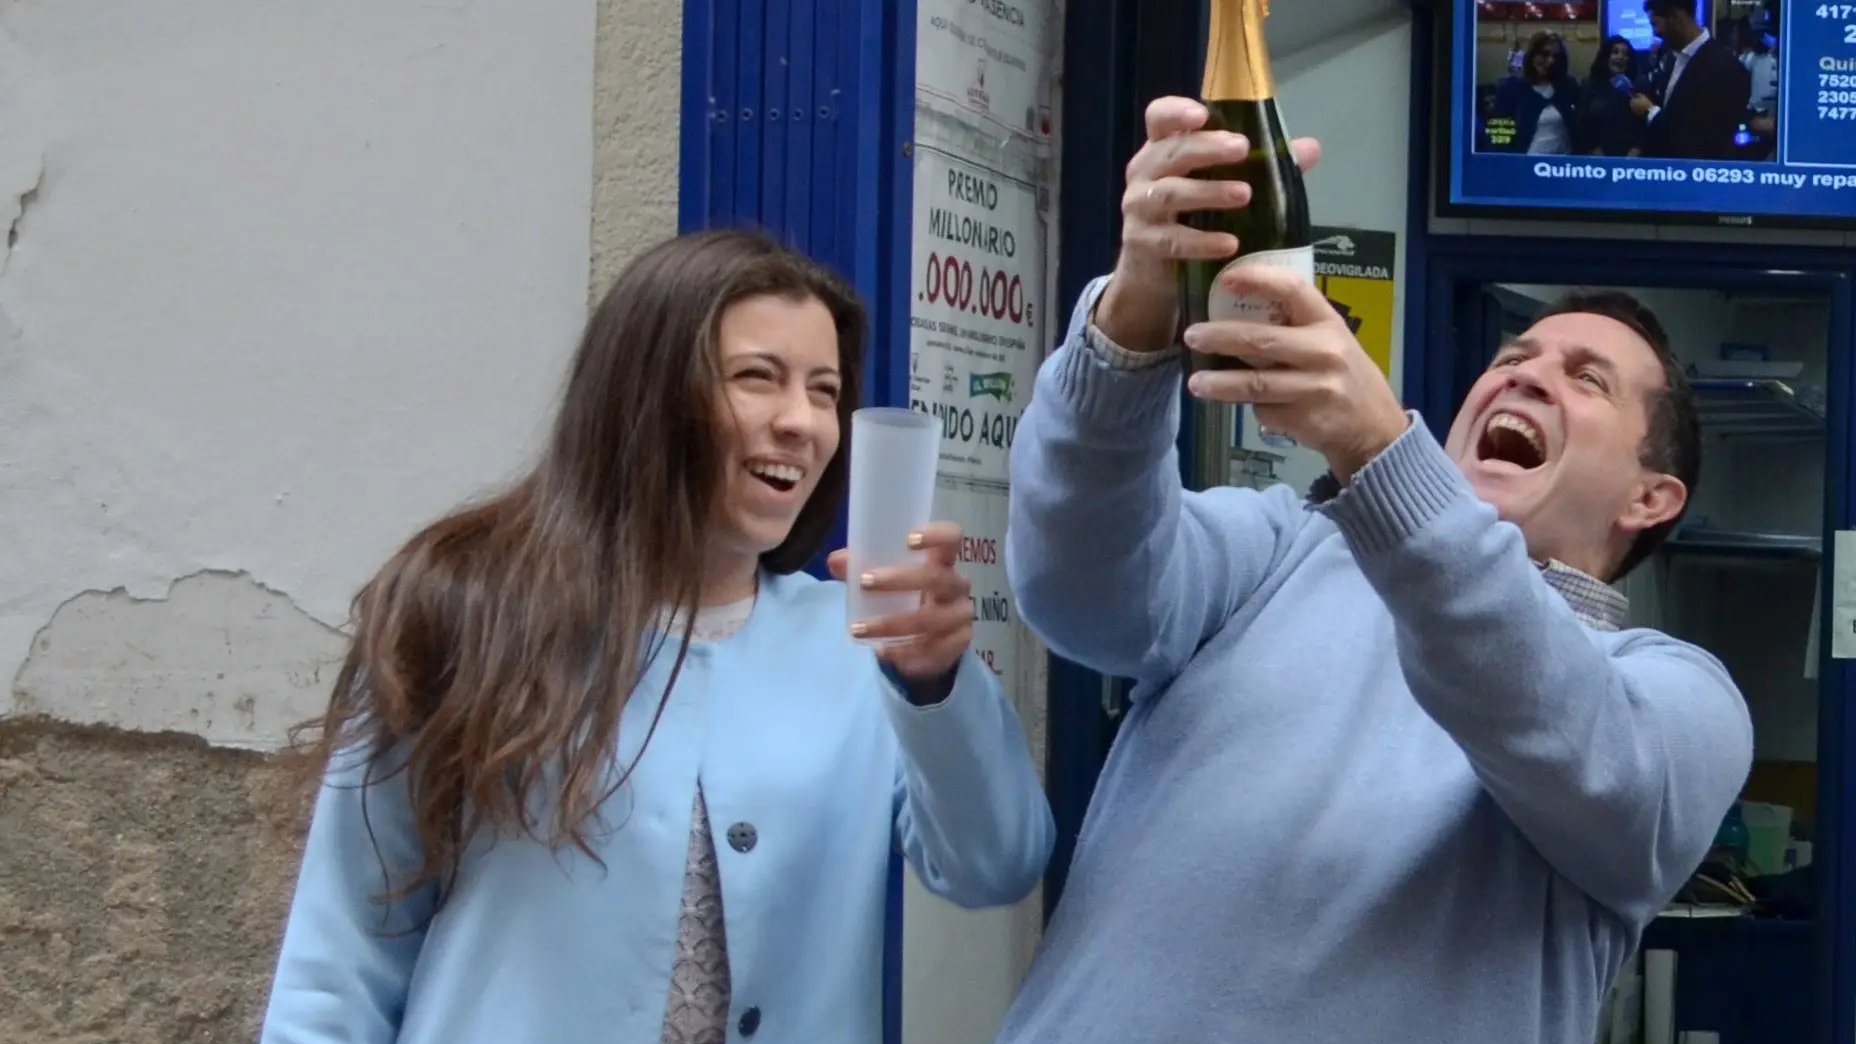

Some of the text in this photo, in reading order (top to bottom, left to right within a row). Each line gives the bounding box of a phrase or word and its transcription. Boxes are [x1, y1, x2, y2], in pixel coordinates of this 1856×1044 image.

[1533, 161, 1607, 180] Quinto
[1611, 165, 1688, 183] premio
[1692, 167, 1755, 184] 06293
[1760, 172, 1806, 189] muy
[979, 406, 1022, 449] AQU
